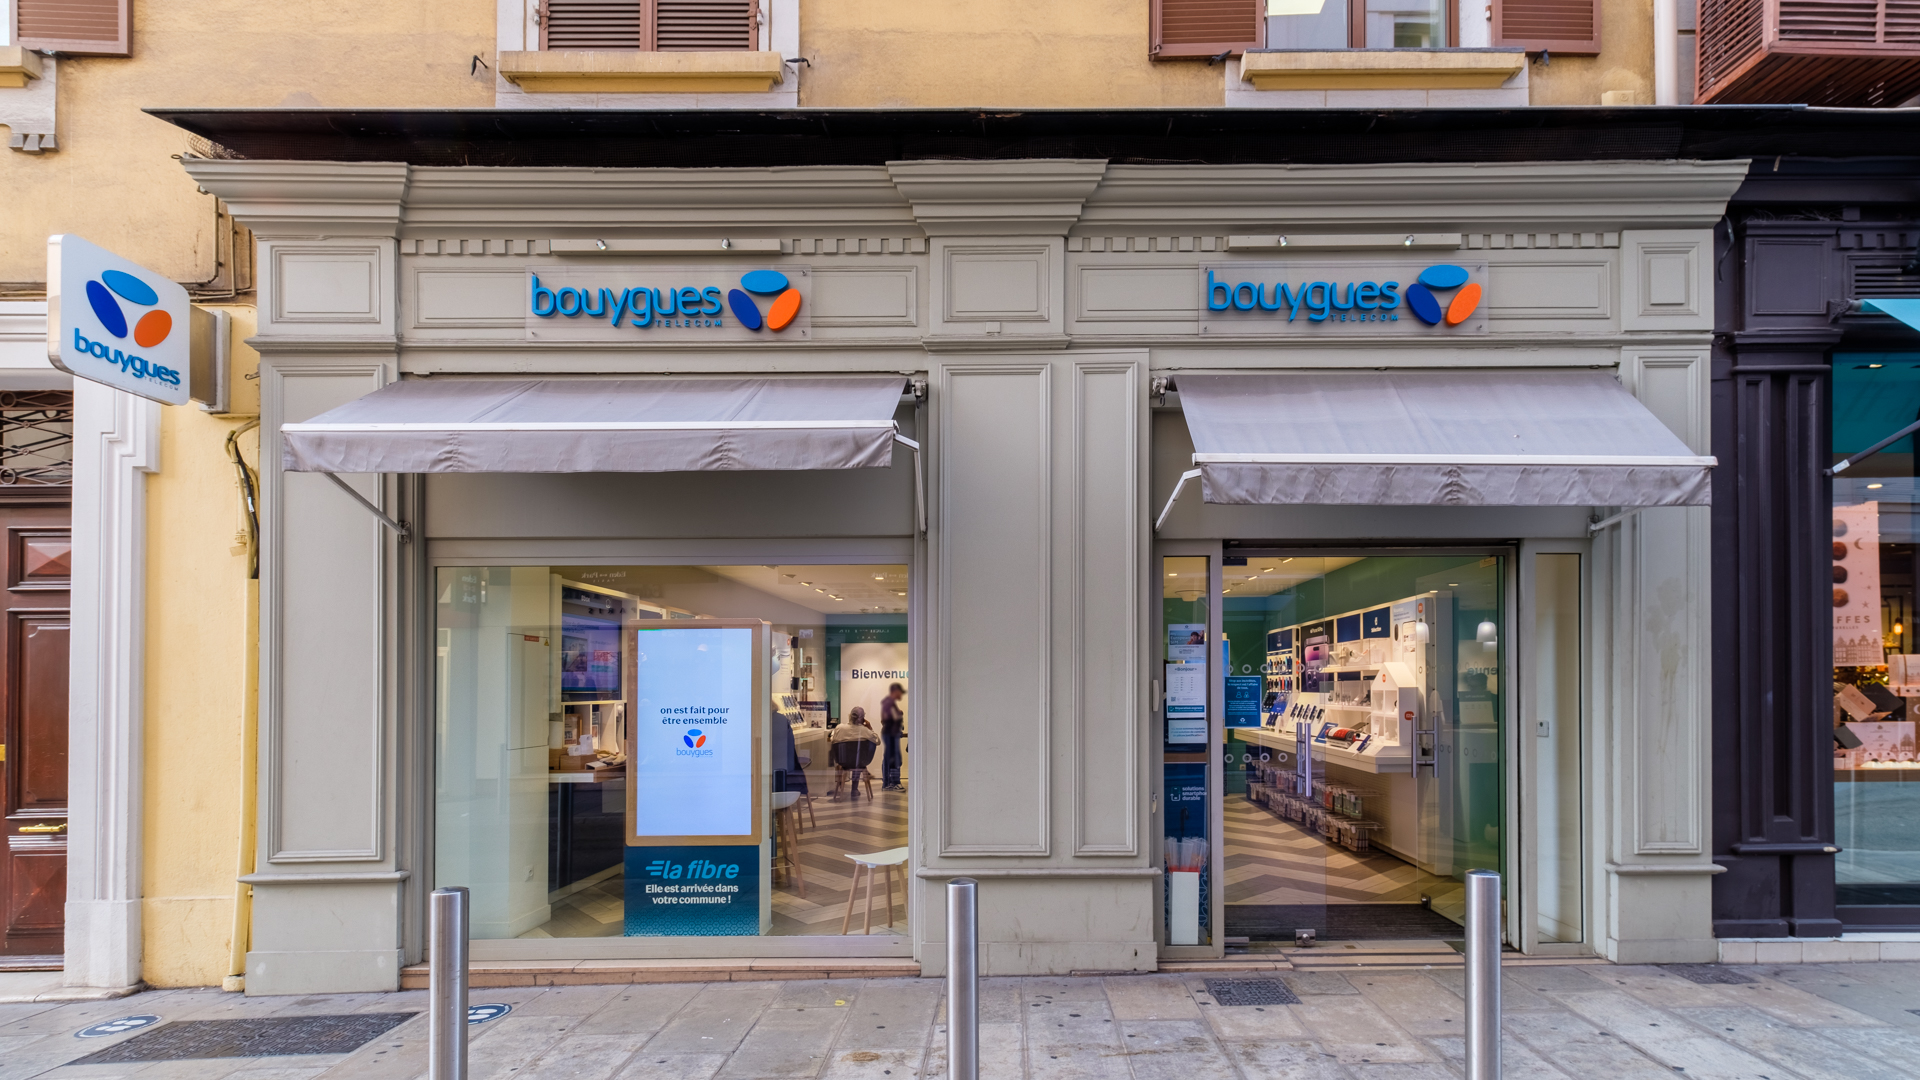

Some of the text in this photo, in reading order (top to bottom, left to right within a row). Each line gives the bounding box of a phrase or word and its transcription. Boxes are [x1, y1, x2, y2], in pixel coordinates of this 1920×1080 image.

[531, 274, 723, 328] bouygues
[1207, 270, 1402, 323] bouygues
[1330, 313, 1399, 322] TELECOM
[654, 319, 722, 328] TELECOM
[74, 327, 181, 385] bouygues
[143, 375, 180, 391] TELECOM
[674, 706, 688, 714] est
[690, 706, 705, 714] fait
[707, 707, 729, 715] pour
[662, 716, 728, 724] être ensemble
[676, 748, 713, 758] bouygues
[663, 859, 740, 880] la fibre
[645, 883, 739, 893] Elle est arrivée dans
[652, 895, 732, 904] votre commune !
